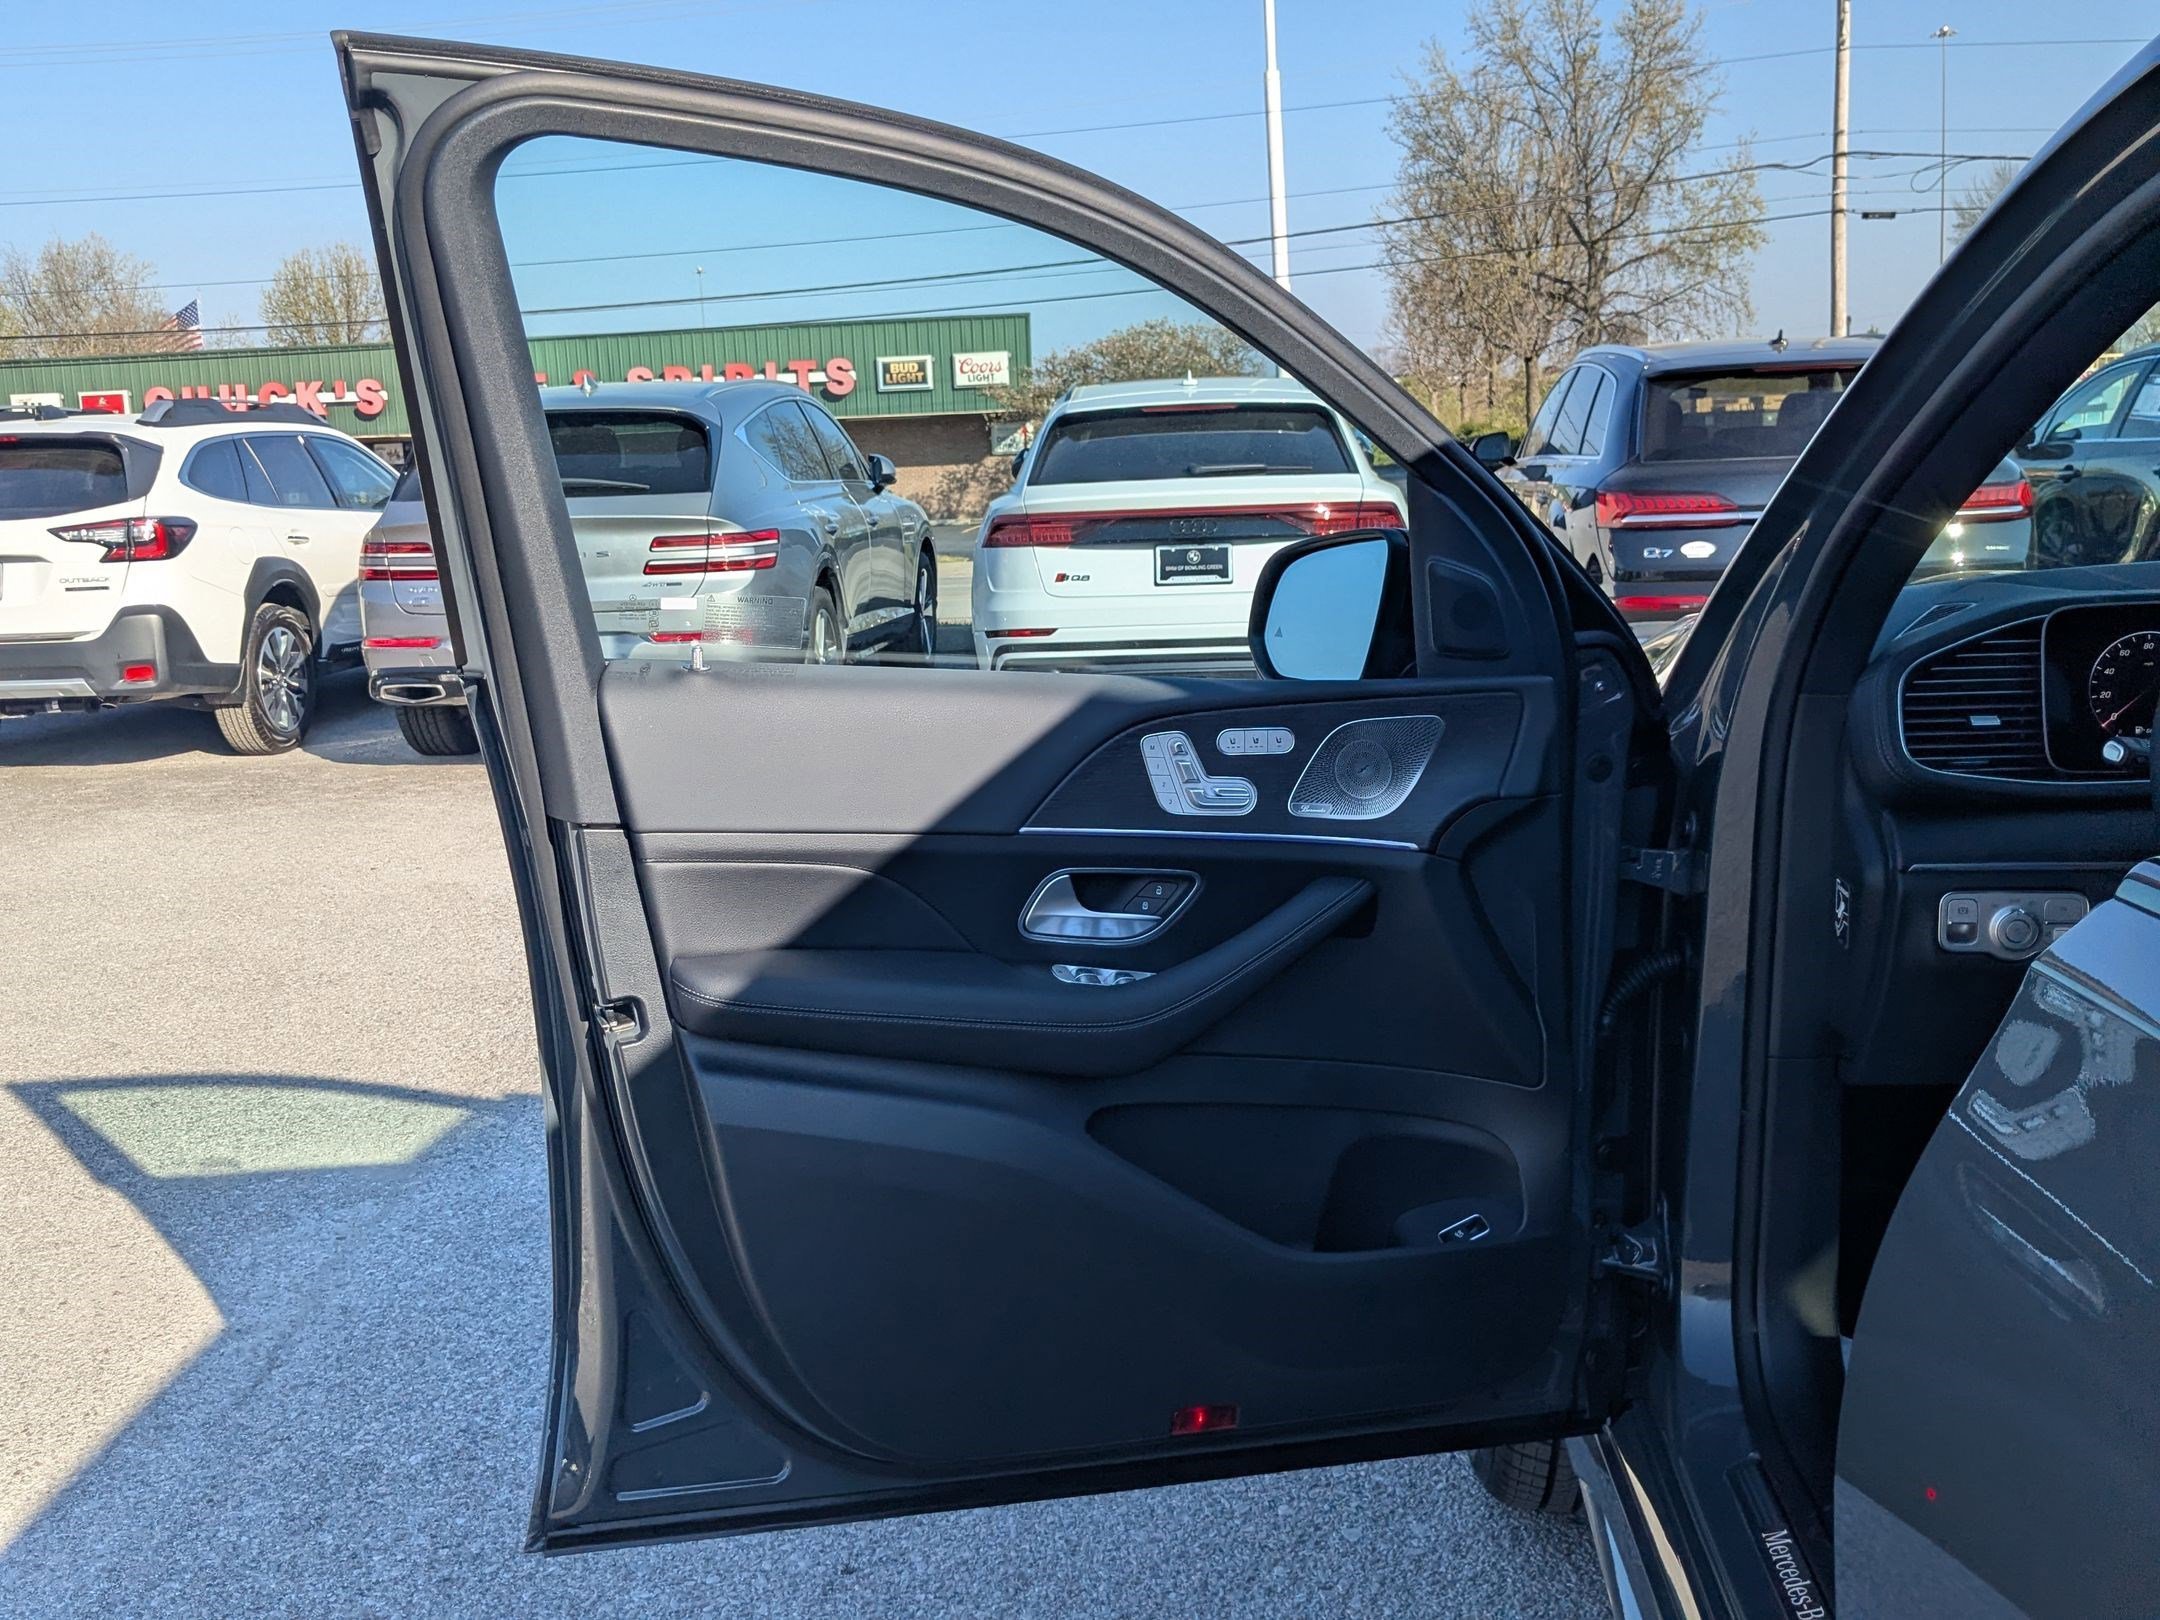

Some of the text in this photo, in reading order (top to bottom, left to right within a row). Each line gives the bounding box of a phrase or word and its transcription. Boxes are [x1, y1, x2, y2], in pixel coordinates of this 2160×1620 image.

[890, 362, 919, 374] BUD
[958, 358, 1003, 375] Coors
[885, 372, 924, 384] LIGHT
[967, 373, 995, 383] LIGHT
[1643, 547, 1674, 558] Q7
[2143, 642, 2155, 650] 80
[2119, 649, 2131, 657] 60
[2103, 667, 2115, 675] 40
[2099, 691, 2111, 699] 20
